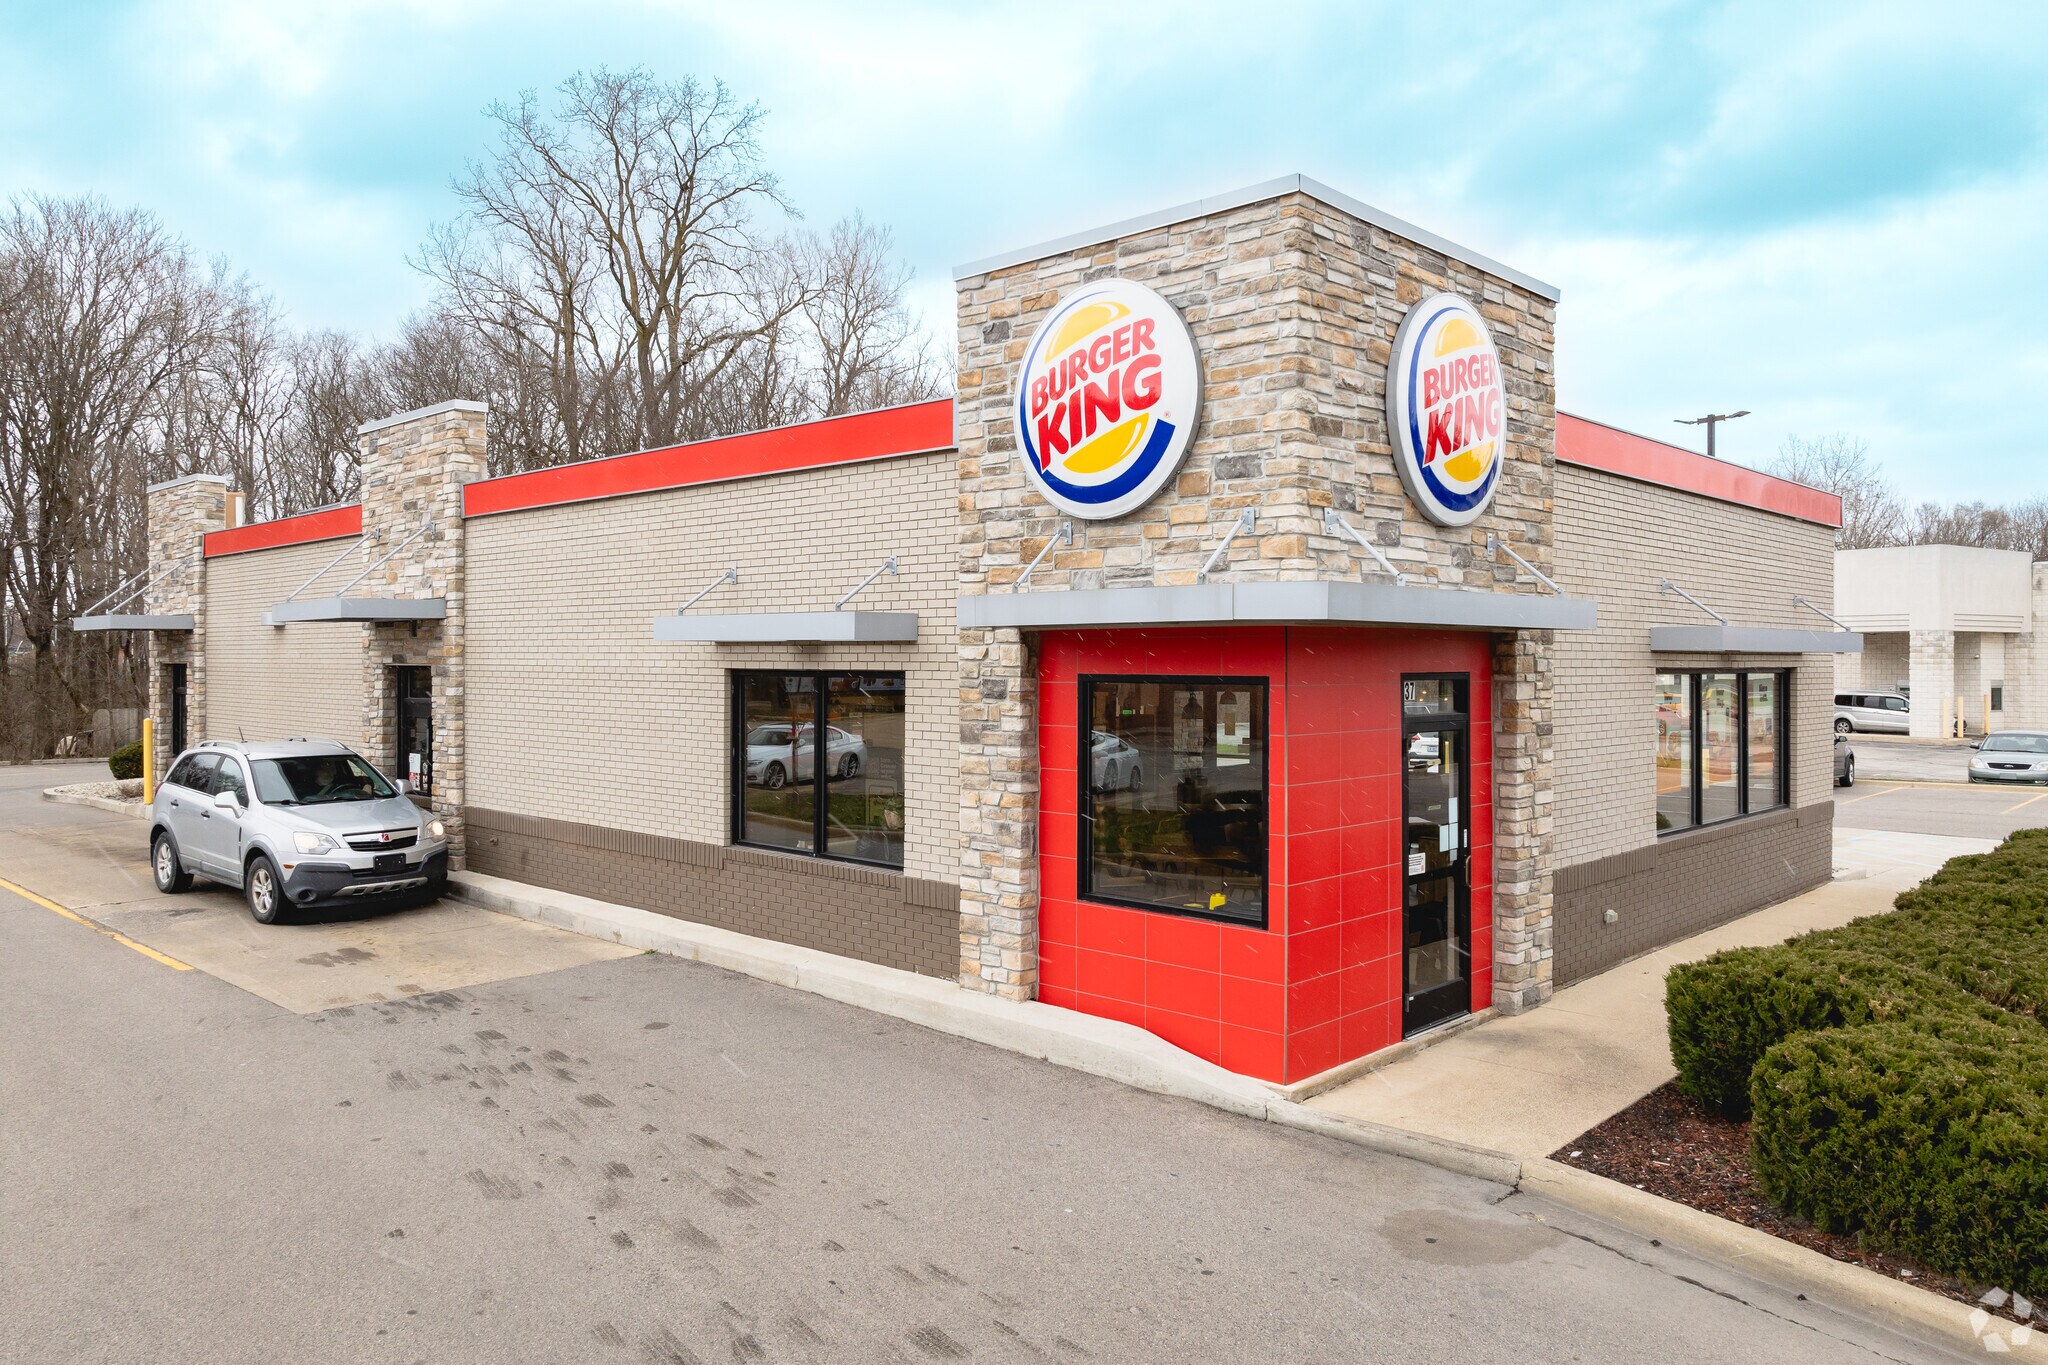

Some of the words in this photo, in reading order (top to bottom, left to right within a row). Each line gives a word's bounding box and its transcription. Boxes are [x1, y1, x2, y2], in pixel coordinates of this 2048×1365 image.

[1032, 318, 1155, 420] BURGER
[1423, 353, 1498, 409] BURGER
[1038, 354, 1162, 471] KING
[1424, 388, 1499, 465] KING
[1404, 682, 1415, 700] 37
